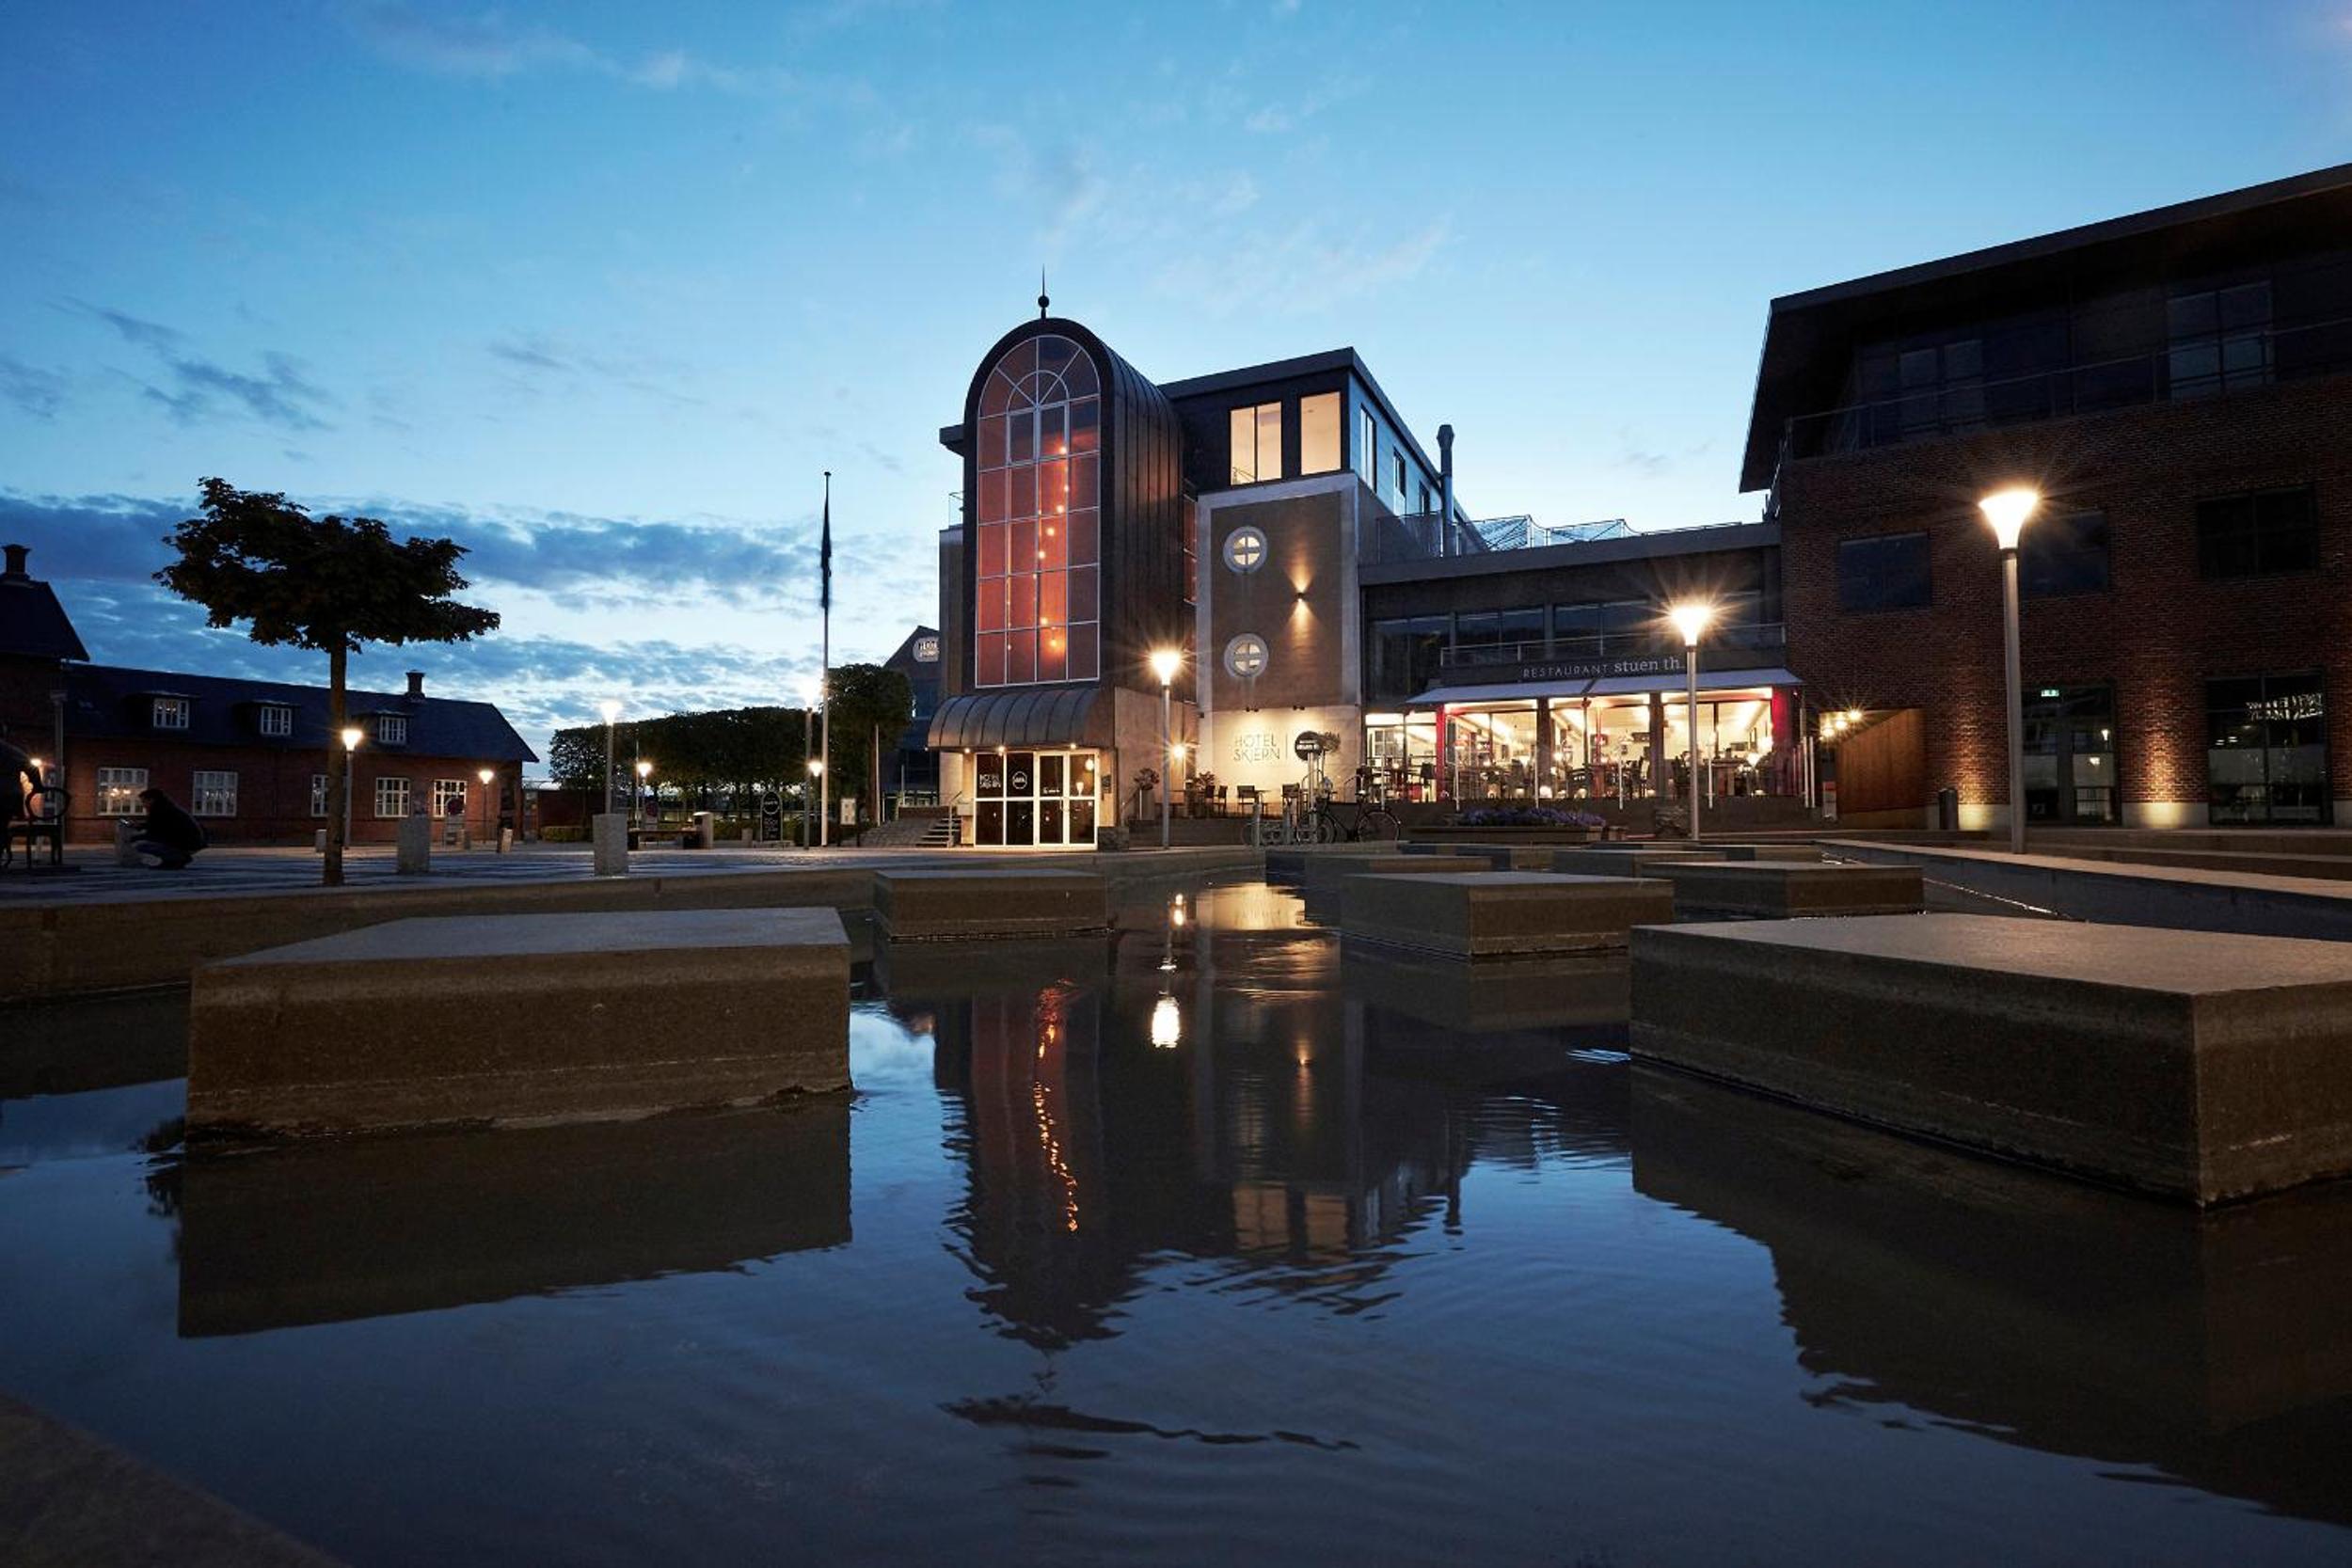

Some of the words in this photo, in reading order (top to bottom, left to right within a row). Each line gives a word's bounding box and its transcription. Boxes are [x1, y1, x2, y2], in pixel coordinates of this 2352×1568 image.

[1522, 664, 1609, 678] RESTAURANT
[1613, 659, 1659, 673] stuen
[1233, 733, 1277, 747] HOTEL
